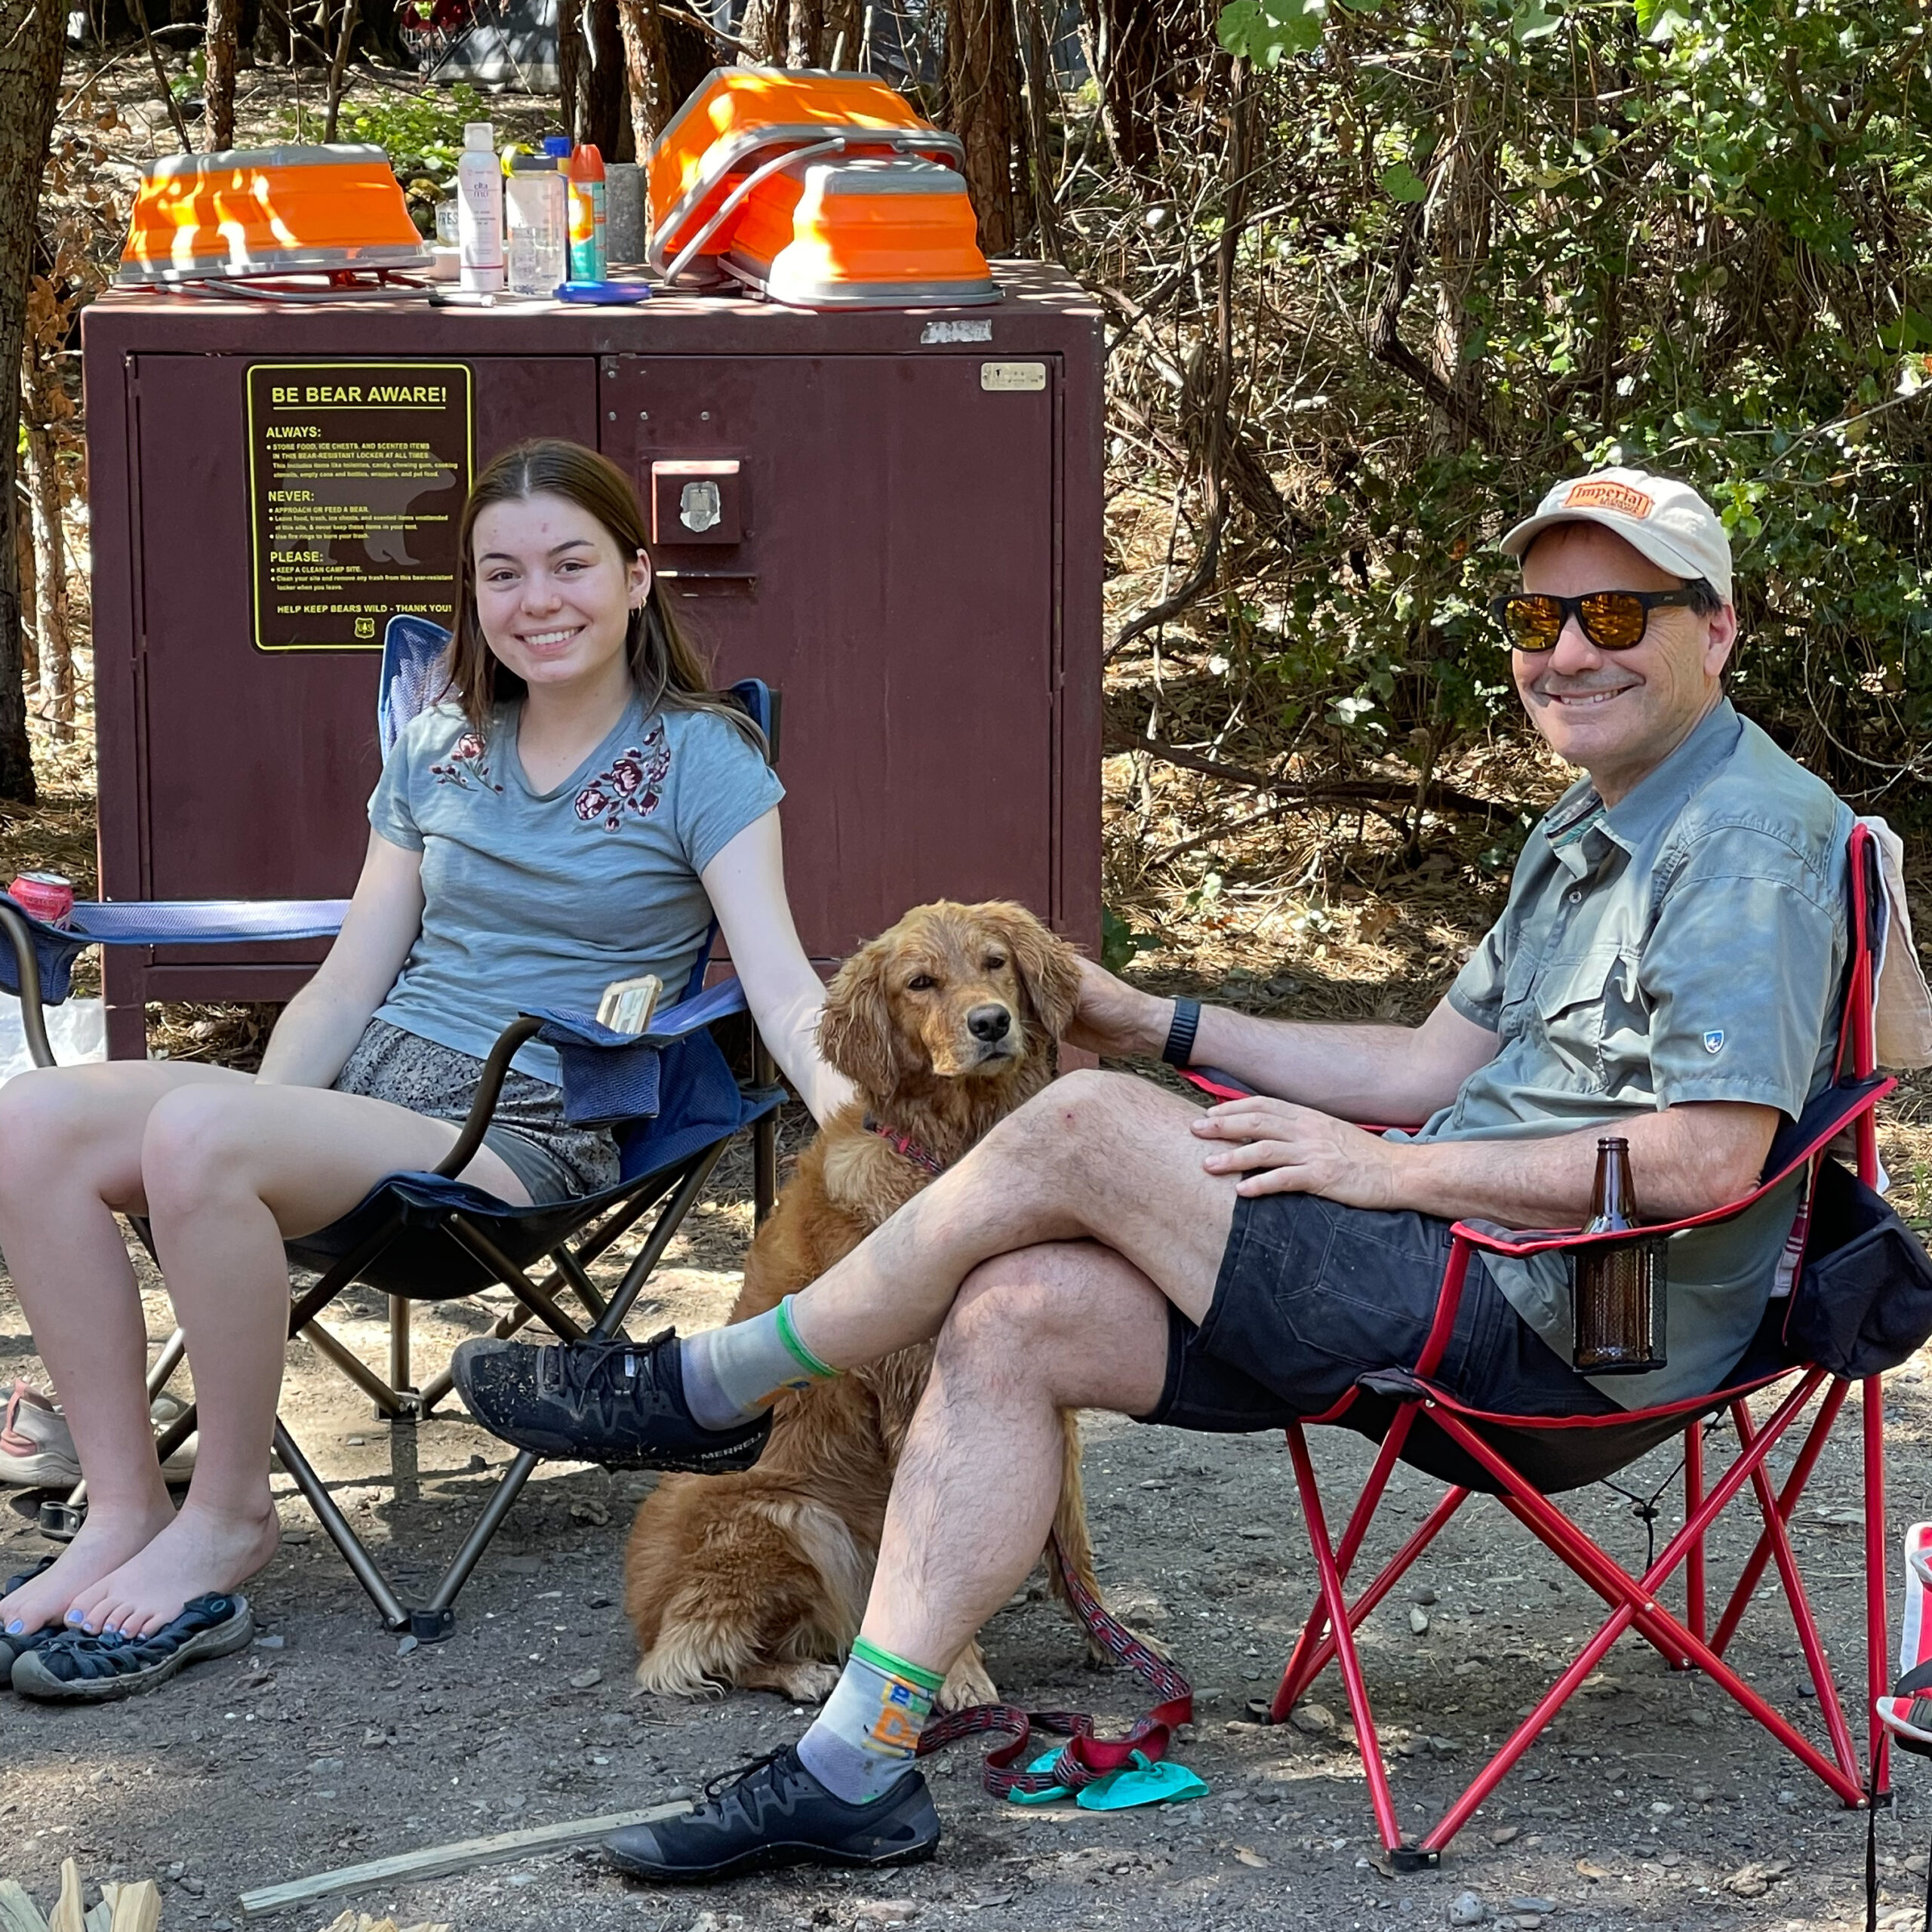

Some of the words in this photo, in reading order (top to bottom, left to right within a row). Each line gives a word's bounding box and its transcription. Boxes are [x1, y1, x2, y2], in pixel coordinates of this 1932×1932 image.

[438, 212, 458, 226] FRES
[272, 387, 299, 403] BE
[306, 386, 362, 402] BEAR
[368, 386, 447, 402] AWARE!
[266, 426, 321, 438] ALWAYS:
[268, 491, 315, 502] NEVER:
[1575, 487, 1643, 507] Imperial
[270, 551, 324, 562] PLEASE:
[277, 605, 301, 614] HELP
[304, 605, 328, 614] KEEP
[330, 605, 361, 614] BEARS
[364, 605, 388, 613] WILD
[396, 605, 427, 613] THANK
[429, 605, 452, 613] YOU!
